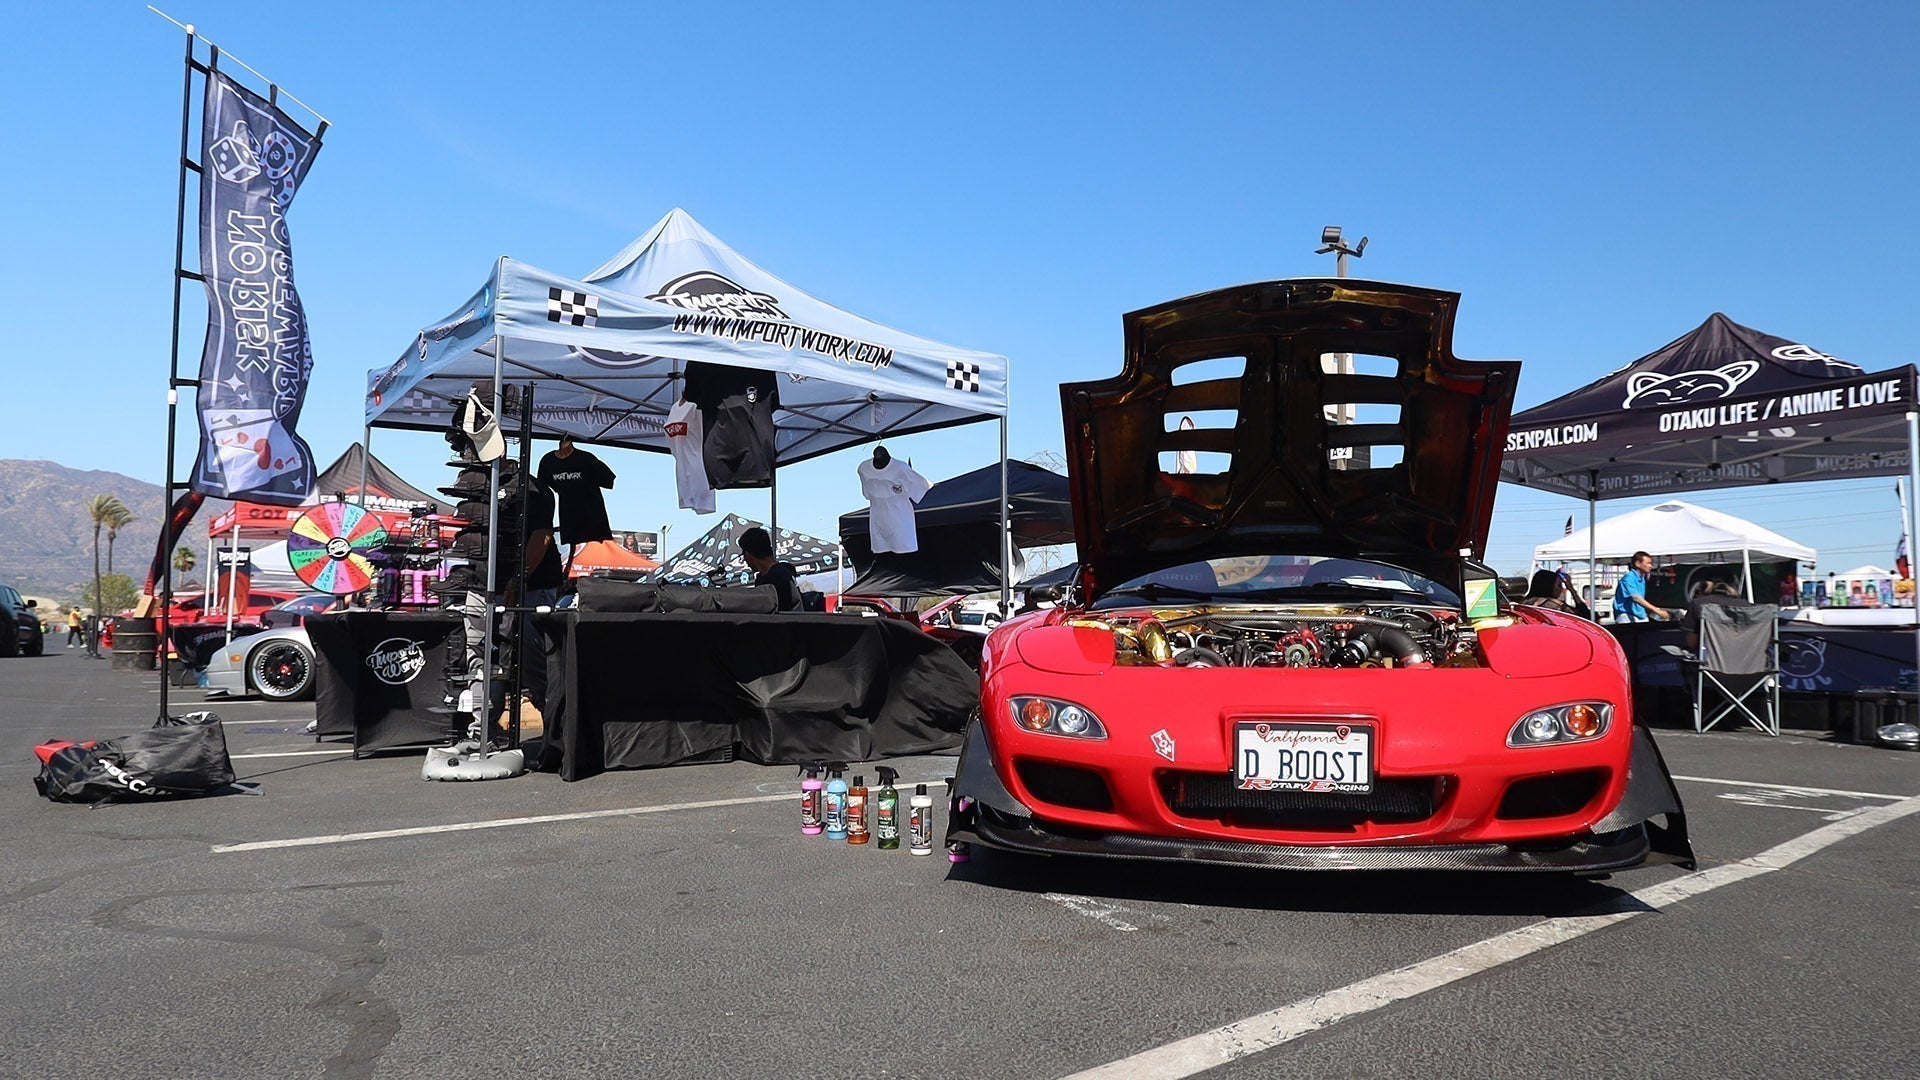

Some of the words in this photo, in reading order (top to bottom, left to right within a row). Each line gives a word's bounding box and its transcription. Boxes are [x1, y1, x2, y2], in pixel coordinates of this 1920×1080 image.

[672, 313, 895, 369] WWW.IMPORTWORX.COM
[1658, 407, 1716, 433] OTAKU
[1718, 401, 1759, 427] LIFE
[1762, 398, 1776, 420] /
[1779, 387, 1844, 418] ANIME
[1847, 378, 1902, 409] LOVE
[1154, 732, 1172, 755] TOW
[1263, 729, 1347, 748] California
[1243, 749, 1259, 779] D
[1278, 749, 1363, 783] BOOST
